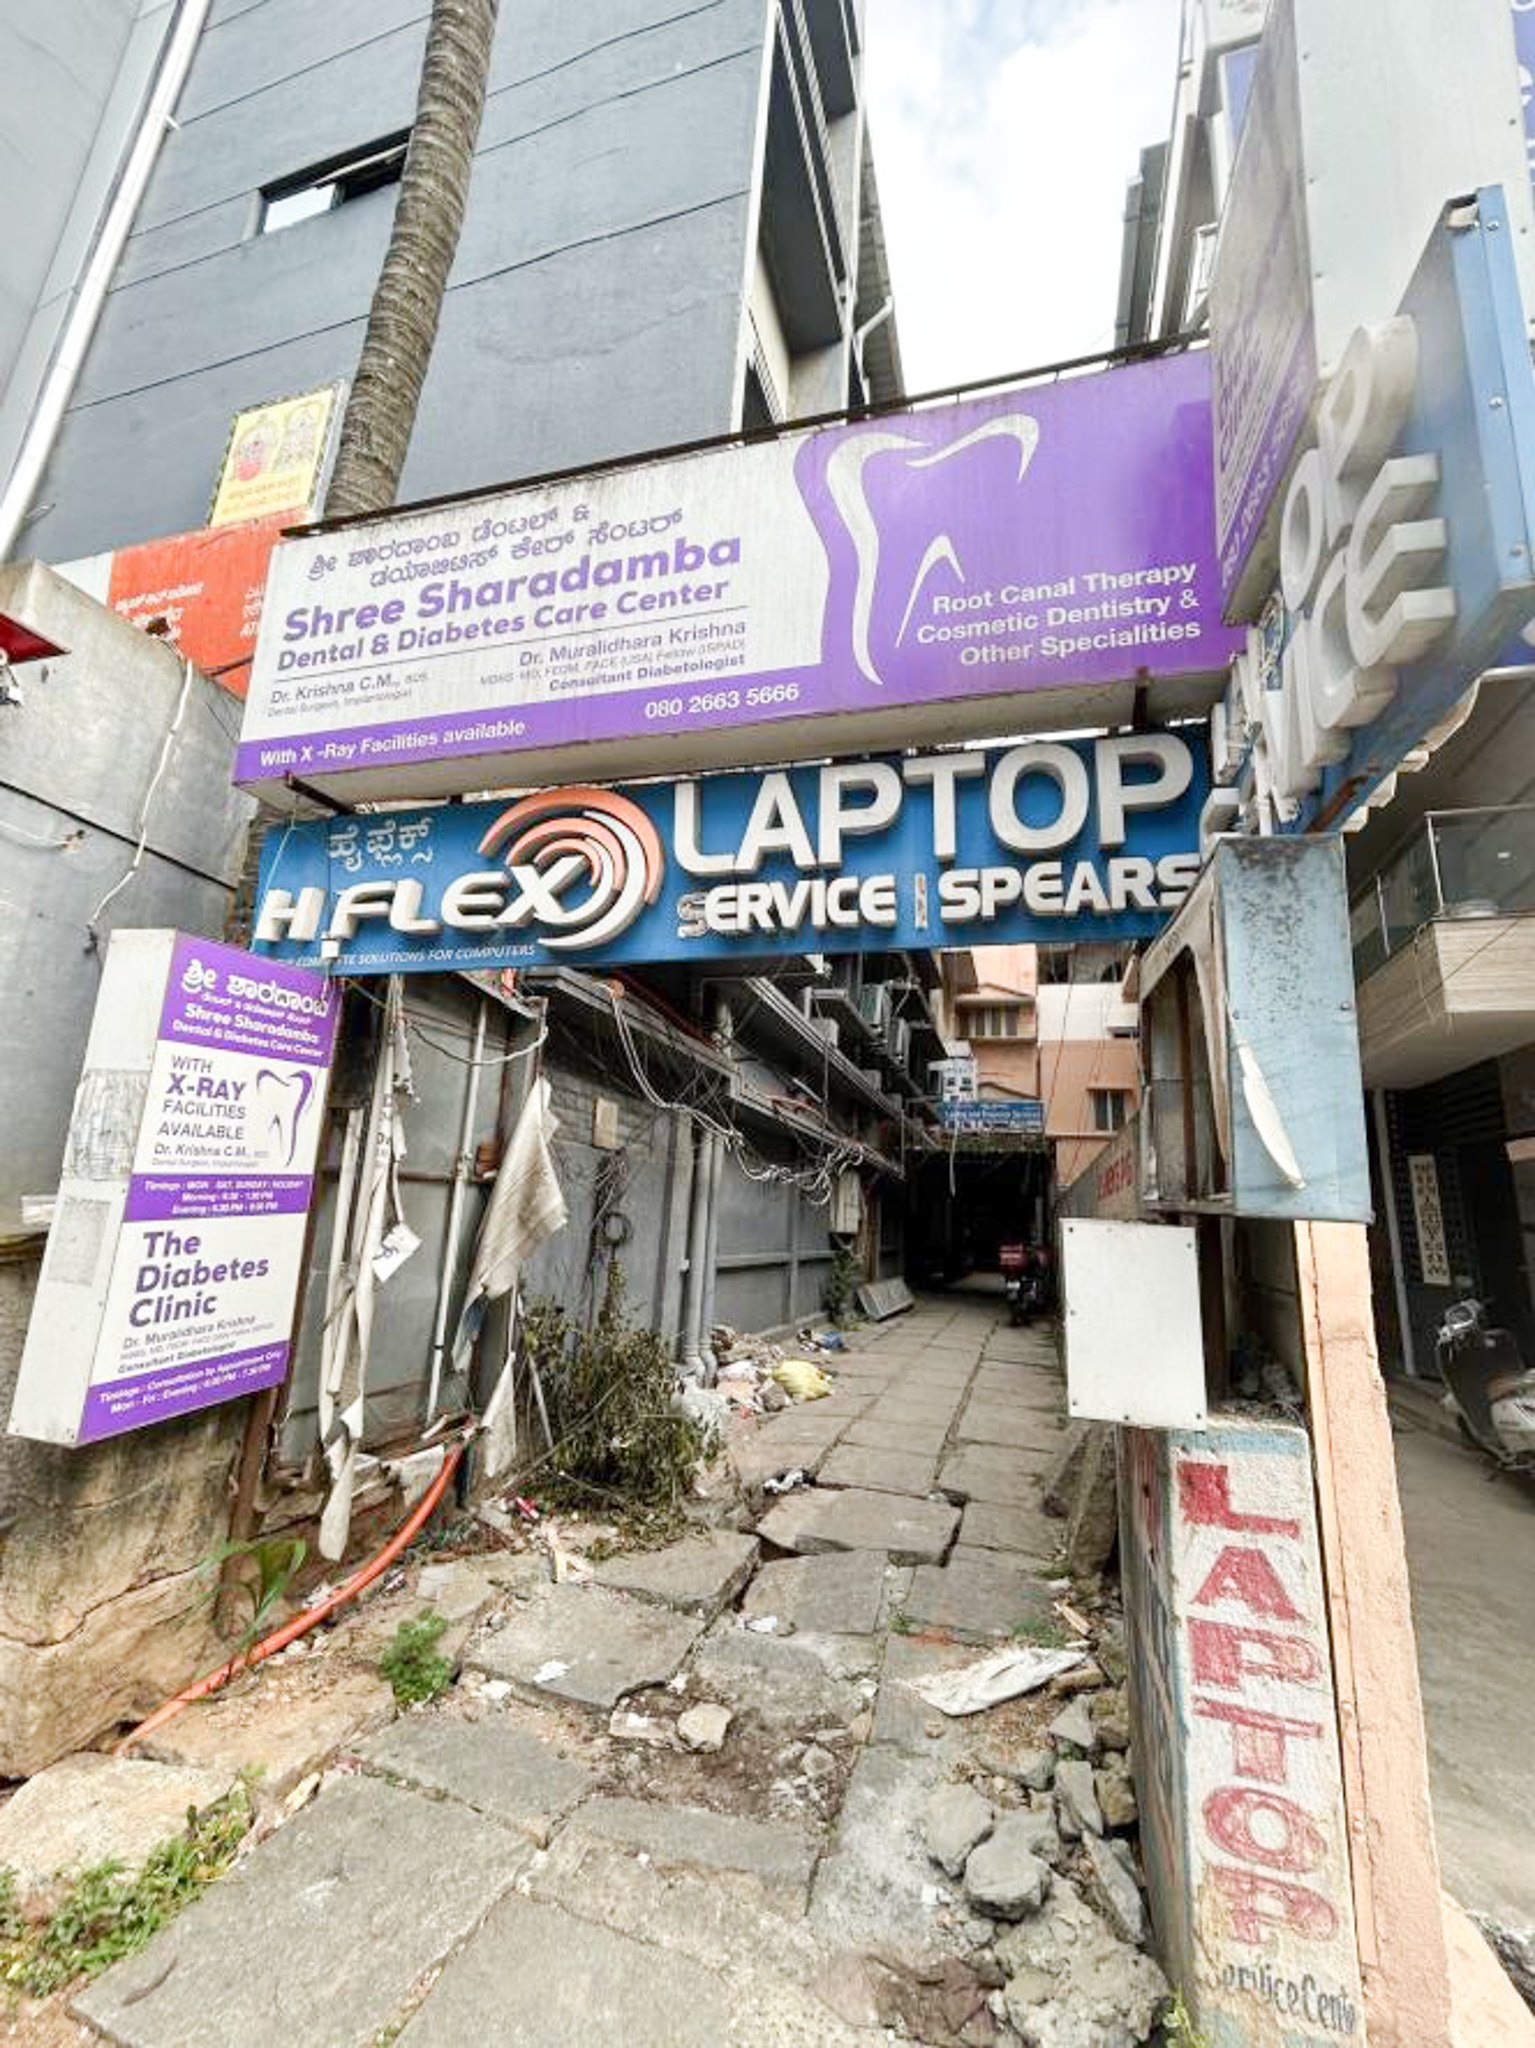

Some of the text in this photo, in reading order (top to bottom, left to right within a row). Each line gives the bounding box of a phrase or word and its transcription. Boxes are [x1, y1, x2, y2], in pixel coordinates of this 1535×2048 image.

[307, 555, 337, 580] ಶ್ರೀ
[283, 599, 405, 642] Shree
[417, 536, 741, 618] Sharadamba
[932, 563, 1197, 615] Root Canal Therapy
[277, 580, 729, 671] Dental & Diabetes Care Center
[917, 589, 1199, 644] Cosmetic Dentistry &
[519, 621, 746, 666] Dr. Muralidhara Krishna
[960, 621, 1201, 665] Other Specialities
[550, 654, 745, 691] Consultant Diabetologist
[270, 690, 289, 704] Dr.
[295, 680, 355, 701] Krishna
[644, 683, 799, 719] 080 2663 5666
[260, 748, 297, 767] With
[361, 731, 438, 754] Facilities
[443, 720, 526, 744] available
[673, 733, 1194, 878] LAPTOP
[677, 852, 1202, 939] SERVICE SPEARS
[358, 953, 425, 965] SOLUTIONS
[428, 949, 453, 961] FOR
[455, 944, 535, 960] COMPUTERS
[181, 958, 217, 993] ಶ್ರೀ
[172, 1019, 211, 1036] Dental
[224, 1031, 269, 1048] Diabetes
[185, 1003, 231, 1025] Shree
[235, 1014, 319, 1043] Sharadamba
[171, 1055, 213, 1074] WITH
[166, 1073, 247, 1101] X-RAY
[163, 1099, 246, 1120] FACILITIES
[157, 1121, 245, 1140] AVAILABLE
[154, 1143, 171, 1155] Dr.
[175, 1143, 221, 1157] Krishna
[143, 1231, 201, 1258] The
[136, 1258, 269, 1294] Diabetes
[129, 1291, 217, 1328] Clinic
[123, 1338, 140, 1350] Dr.
[145, 1325, 214, 1345] Muralidhara
[217, 1316, 256, 1330] Krishna
[118, 1341, 236, 1374] Consultant Diabetologist
[1176, 1460, 1340, 1945] LAPTOP
